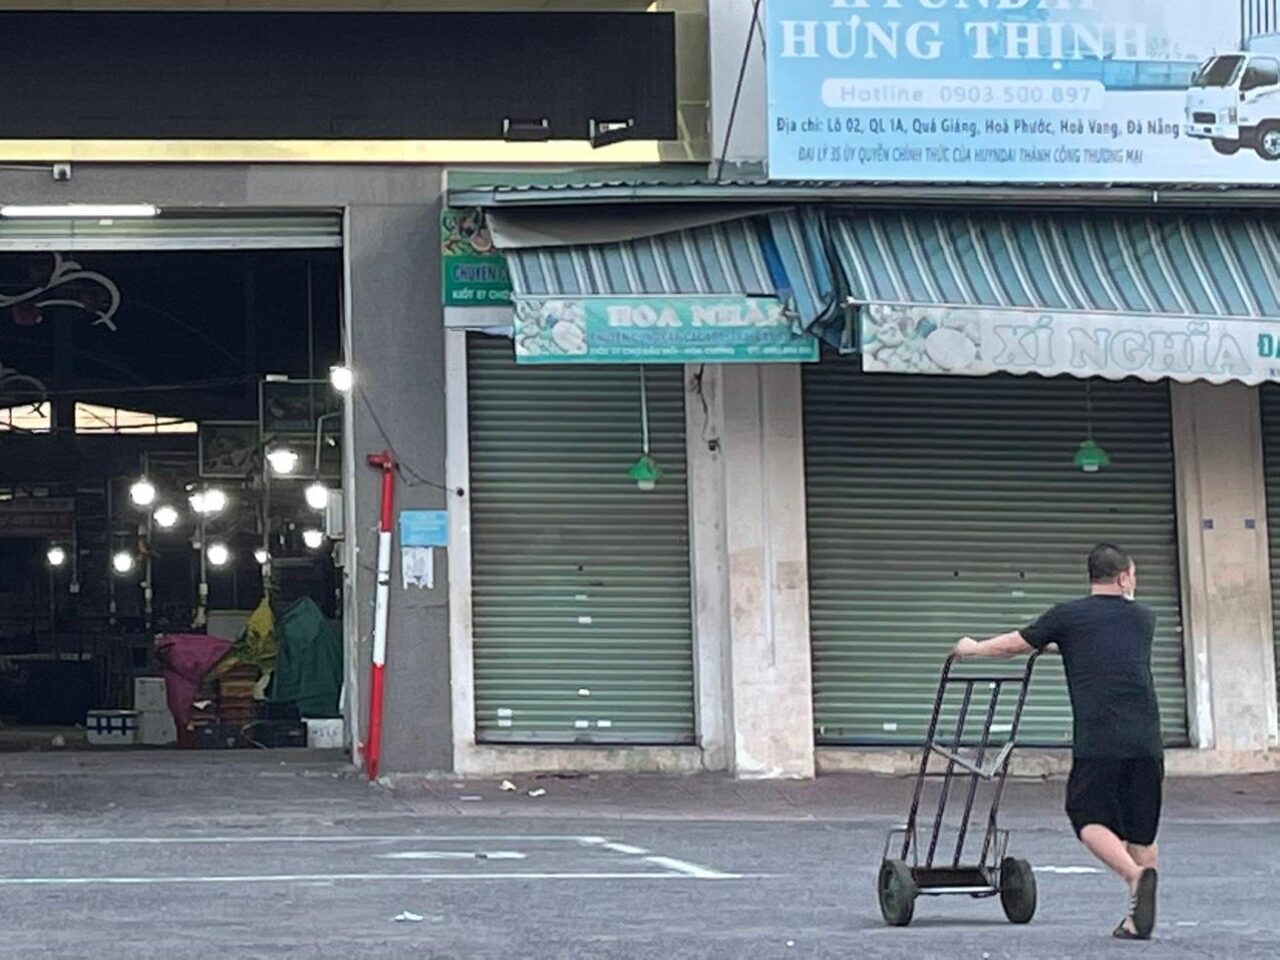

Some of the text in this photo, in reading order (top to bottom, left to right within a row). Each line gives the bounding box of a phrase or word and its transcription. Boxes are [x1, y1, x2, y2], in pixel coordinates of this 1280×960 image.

[779, 14, 1150, 70] HƯNG THỊNH
[940, 86, 994, 104] 0903
[1003, 86, 1044, 104] 500
[1052, 86, 1091, 104] 897
[776, 117, 797, 135] Địa
[827, 118, 842, 133] Lô
[846, 119, 865, 135] 02,
[869, 119, 885, 134] QL
[890, 119, 907, 135] 1A,
[1126, 119, 1142, 135] Đà
[1147, 118, 1179, 138] Nẵng
[1069, 321, 1251, 376] NGHĨA
